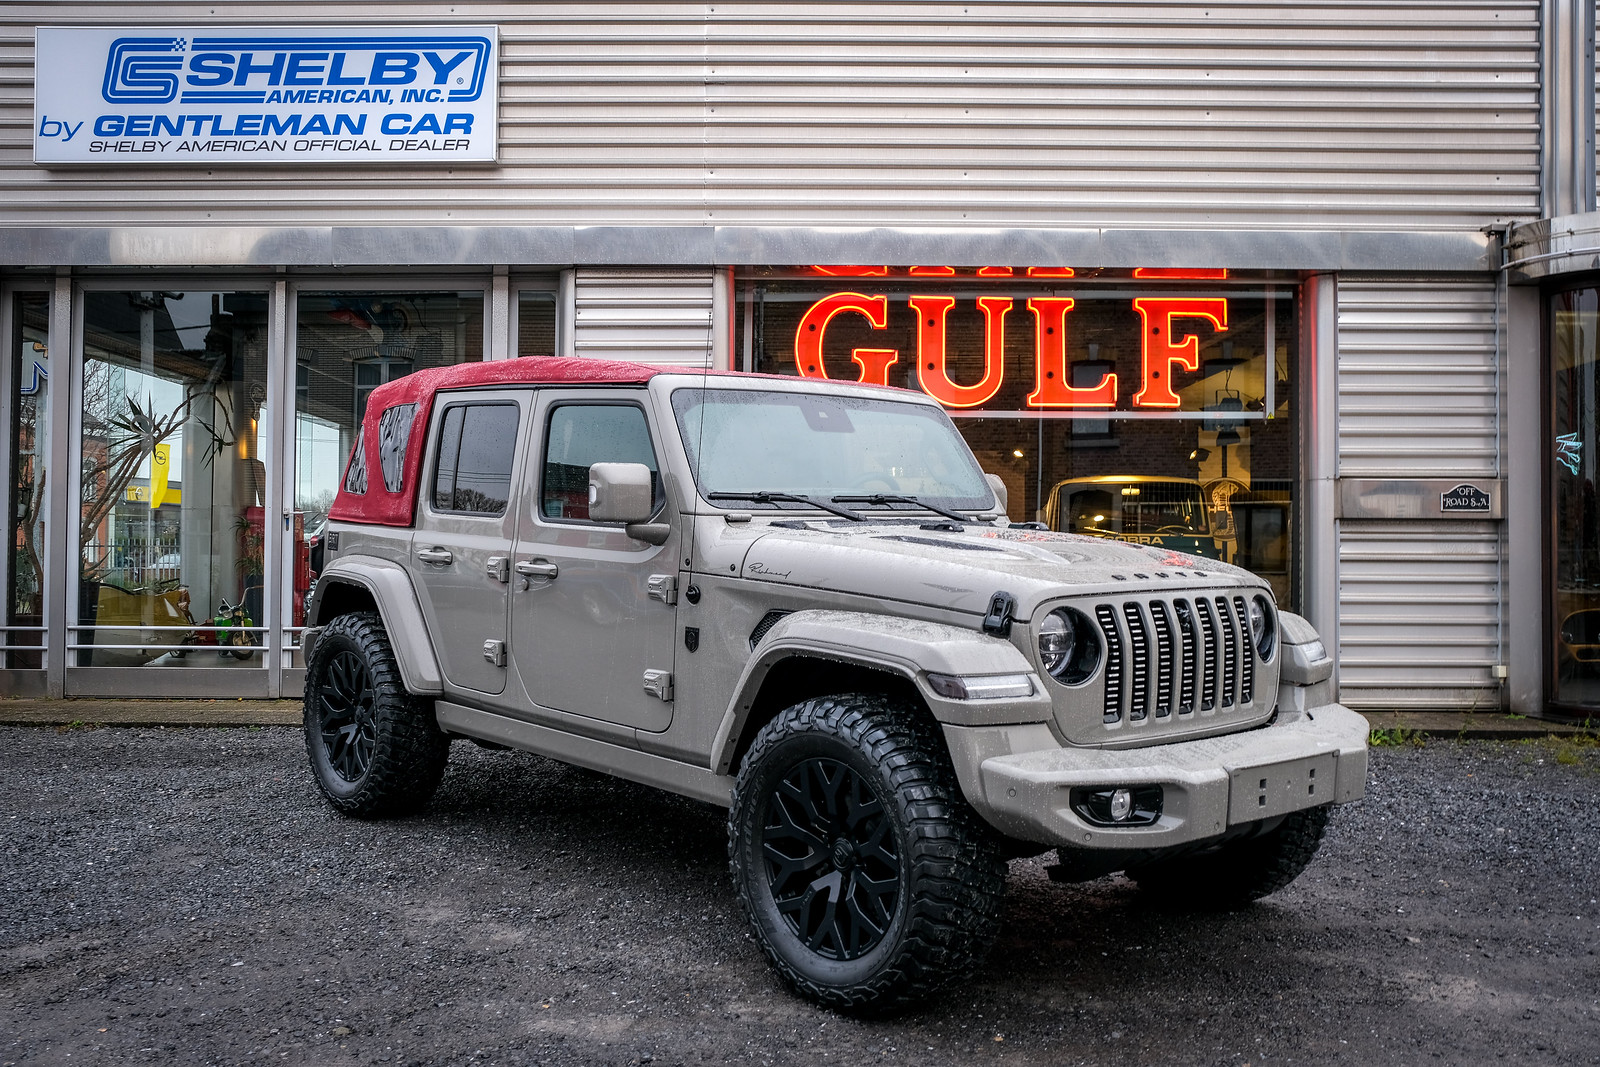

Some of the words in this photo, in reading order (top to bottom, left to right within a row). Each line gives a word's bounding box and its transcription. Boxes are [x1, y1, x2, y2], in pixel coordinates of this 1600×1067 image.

[186, 51, 474, 86] SHELBY
[266, 89, 394, 105] AMERICAN,
[400, 89, 445, 103] INC.
[39, 115, 84, 142] by
[93, 113, 368, 136] GENTLEMAN
[380, 113, 475, 135] CAR
[89, 140, 172, 153] SHELBY
[175, 140, 288, 152] AMERICAN
[293, 140, 382, 152] OFFICIAL
[389, 139, 470, 151] DEALER
[794, 291, 1228, 407] GULF
